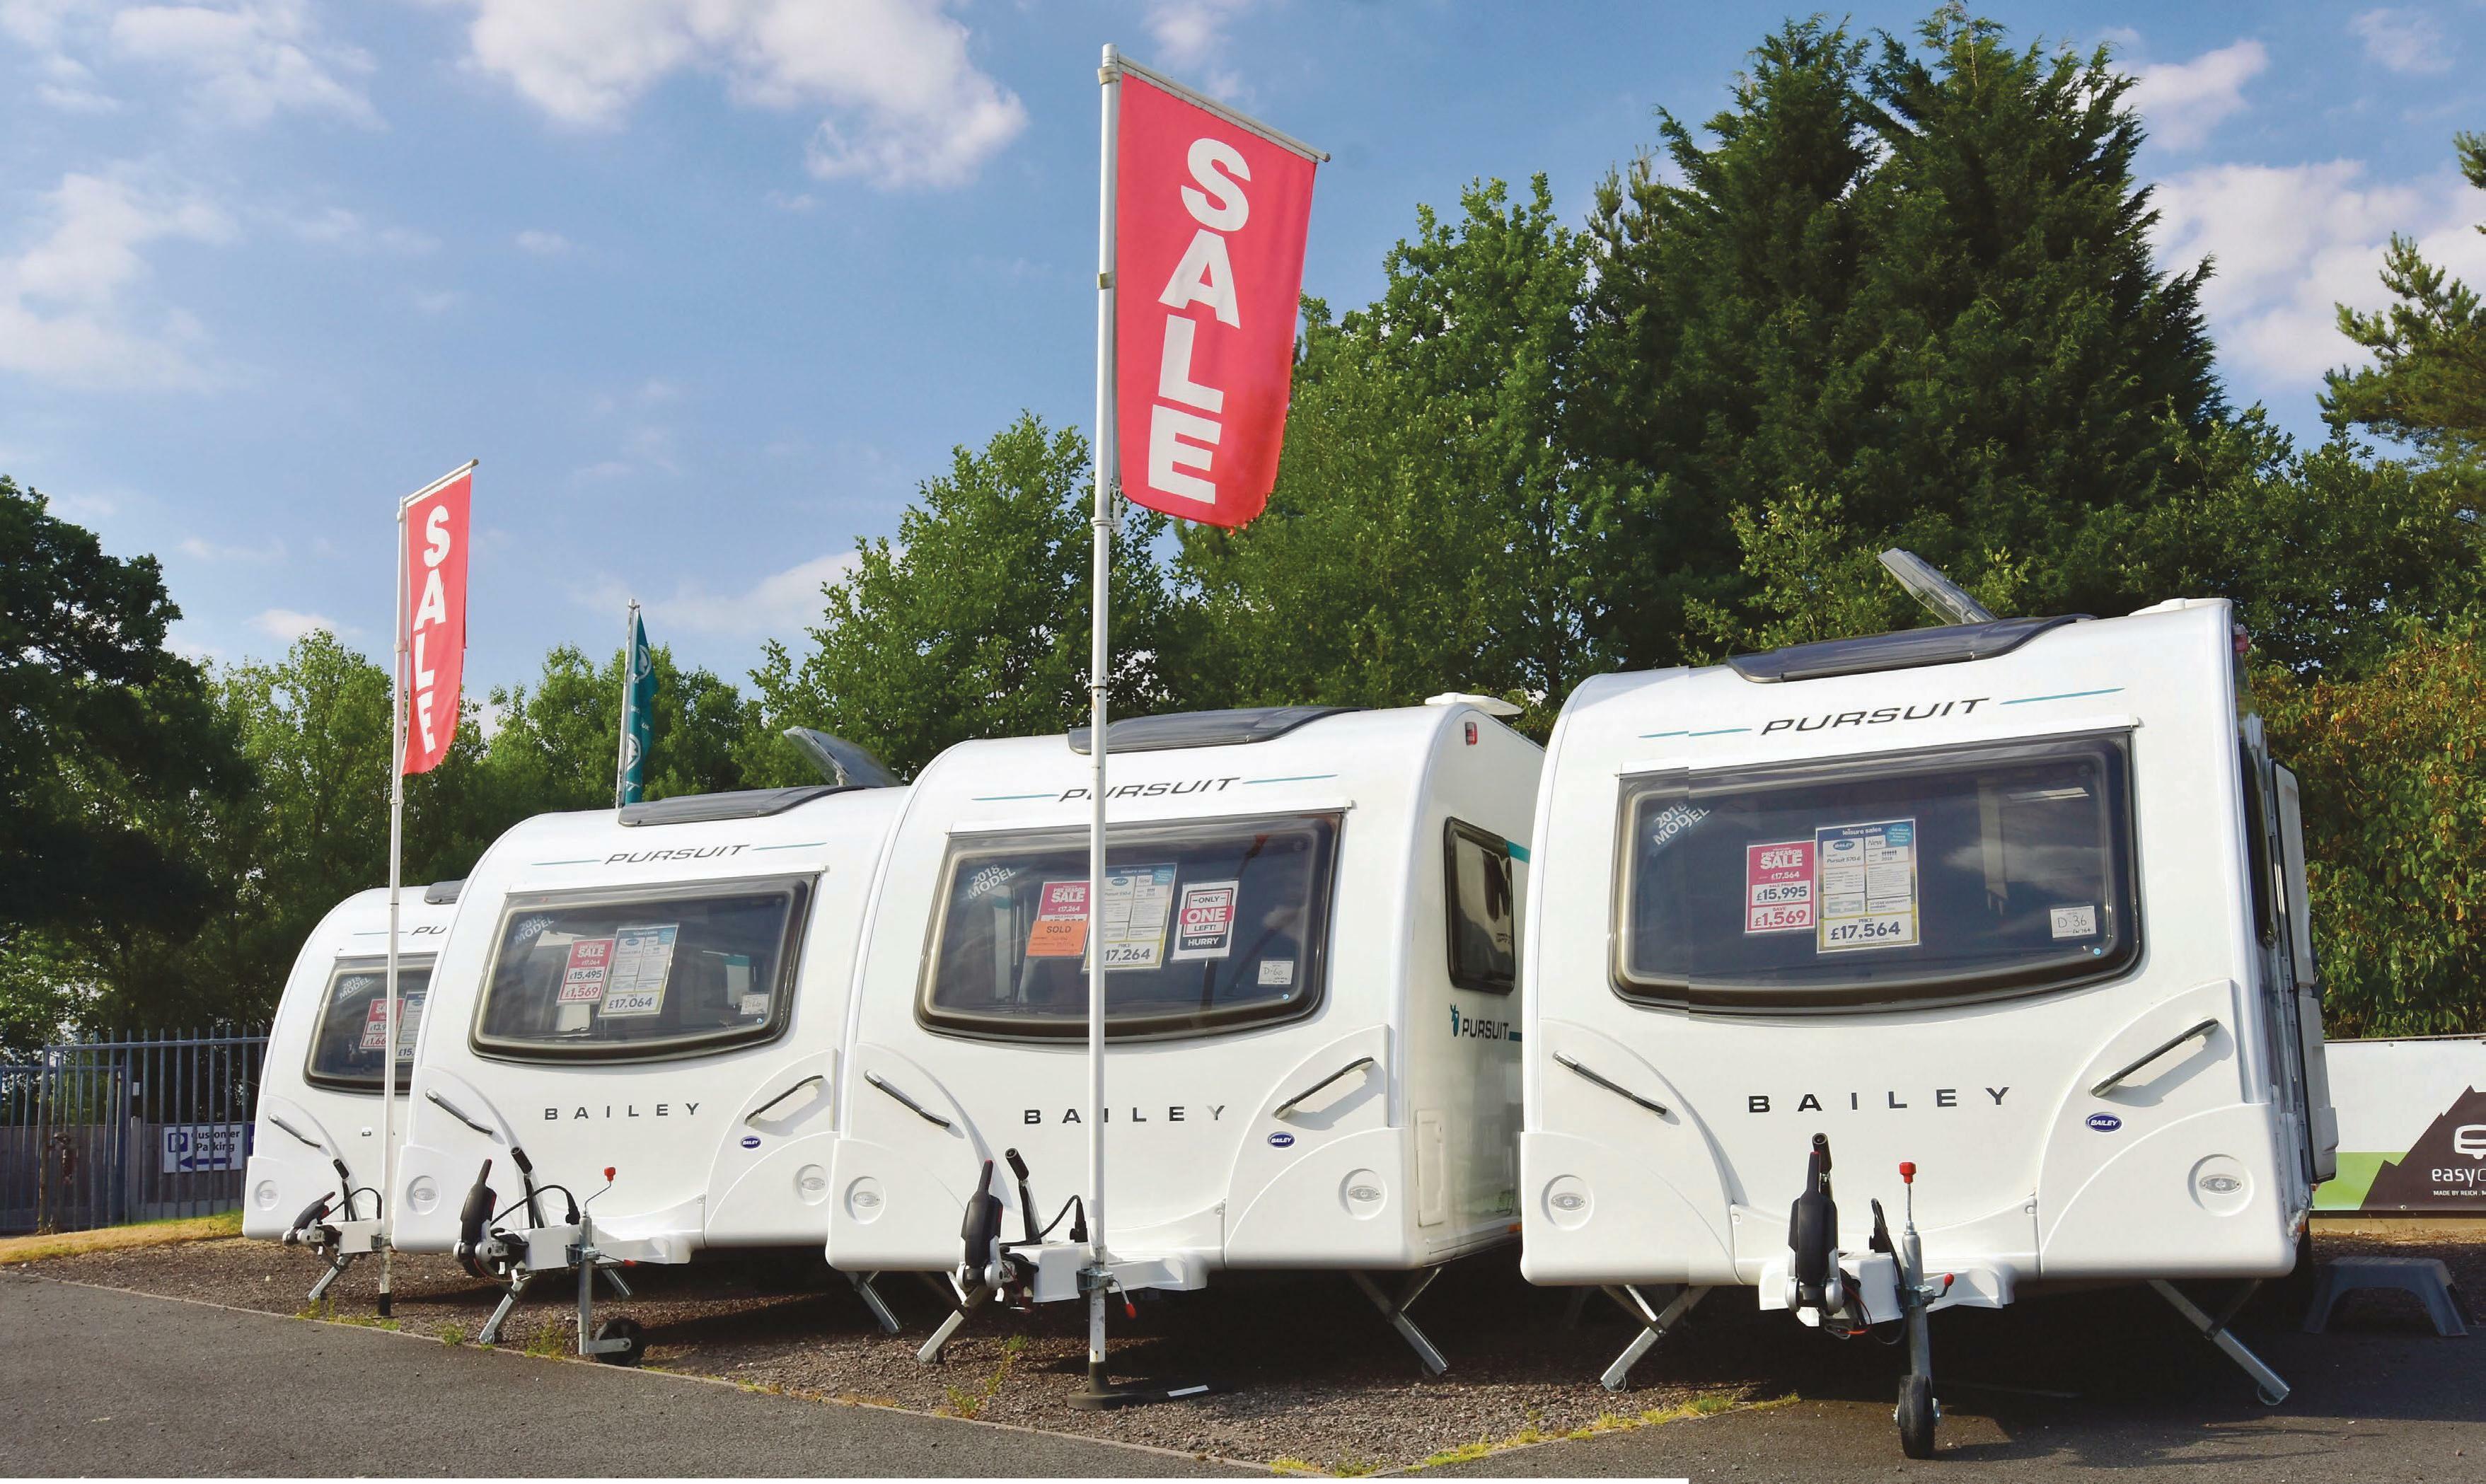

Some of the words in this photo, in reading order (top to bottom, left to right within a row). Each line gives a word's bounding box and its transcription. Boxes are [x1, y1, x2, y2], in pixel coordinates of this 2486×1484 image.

[1148, 138, 1251, 504] SALE
[413, 505, 451, 754] SALE
[1761, 697, 1990, 736] PURSUIT
[1653, 807, 1711, 845] MODEL
[605, 844, 751, 864] PURSUIT
[1760, 854, 1803, 869] SALE
[968, 868, 1016, 899] MODEL
[971, 864, 1000, 885] 2018
[1051, 891, 1085, 903] SALE
[1756, 886, 1808, 900] £15,995
[1186, 908, 1227, 923] ONE
[1754, 910, 1806, 926] £1,569
[514, 917, 555, 944] MODEL
[1830, 921, 1901, 940] £17,564
[1189, 937, 1220, 946] HURRY
[577, 948, 604, 958] SALE
[1105, 949, 1150, 962] 17,264
[340, 978, 371, 999] MODEL
[565, 987, 598, 997] £1,569
[1462, 1018, 1510, 1040] PURSUIT
[1748, 1086, 2010, 1113] BAILEY
[544, 1103, 700, 1120] BAILEY
[1024, 1105, 1225, 1125] BAILEY
[191, 1131, 241, 1140] usomer
[197, 1142, 235, 1152] Pakig
